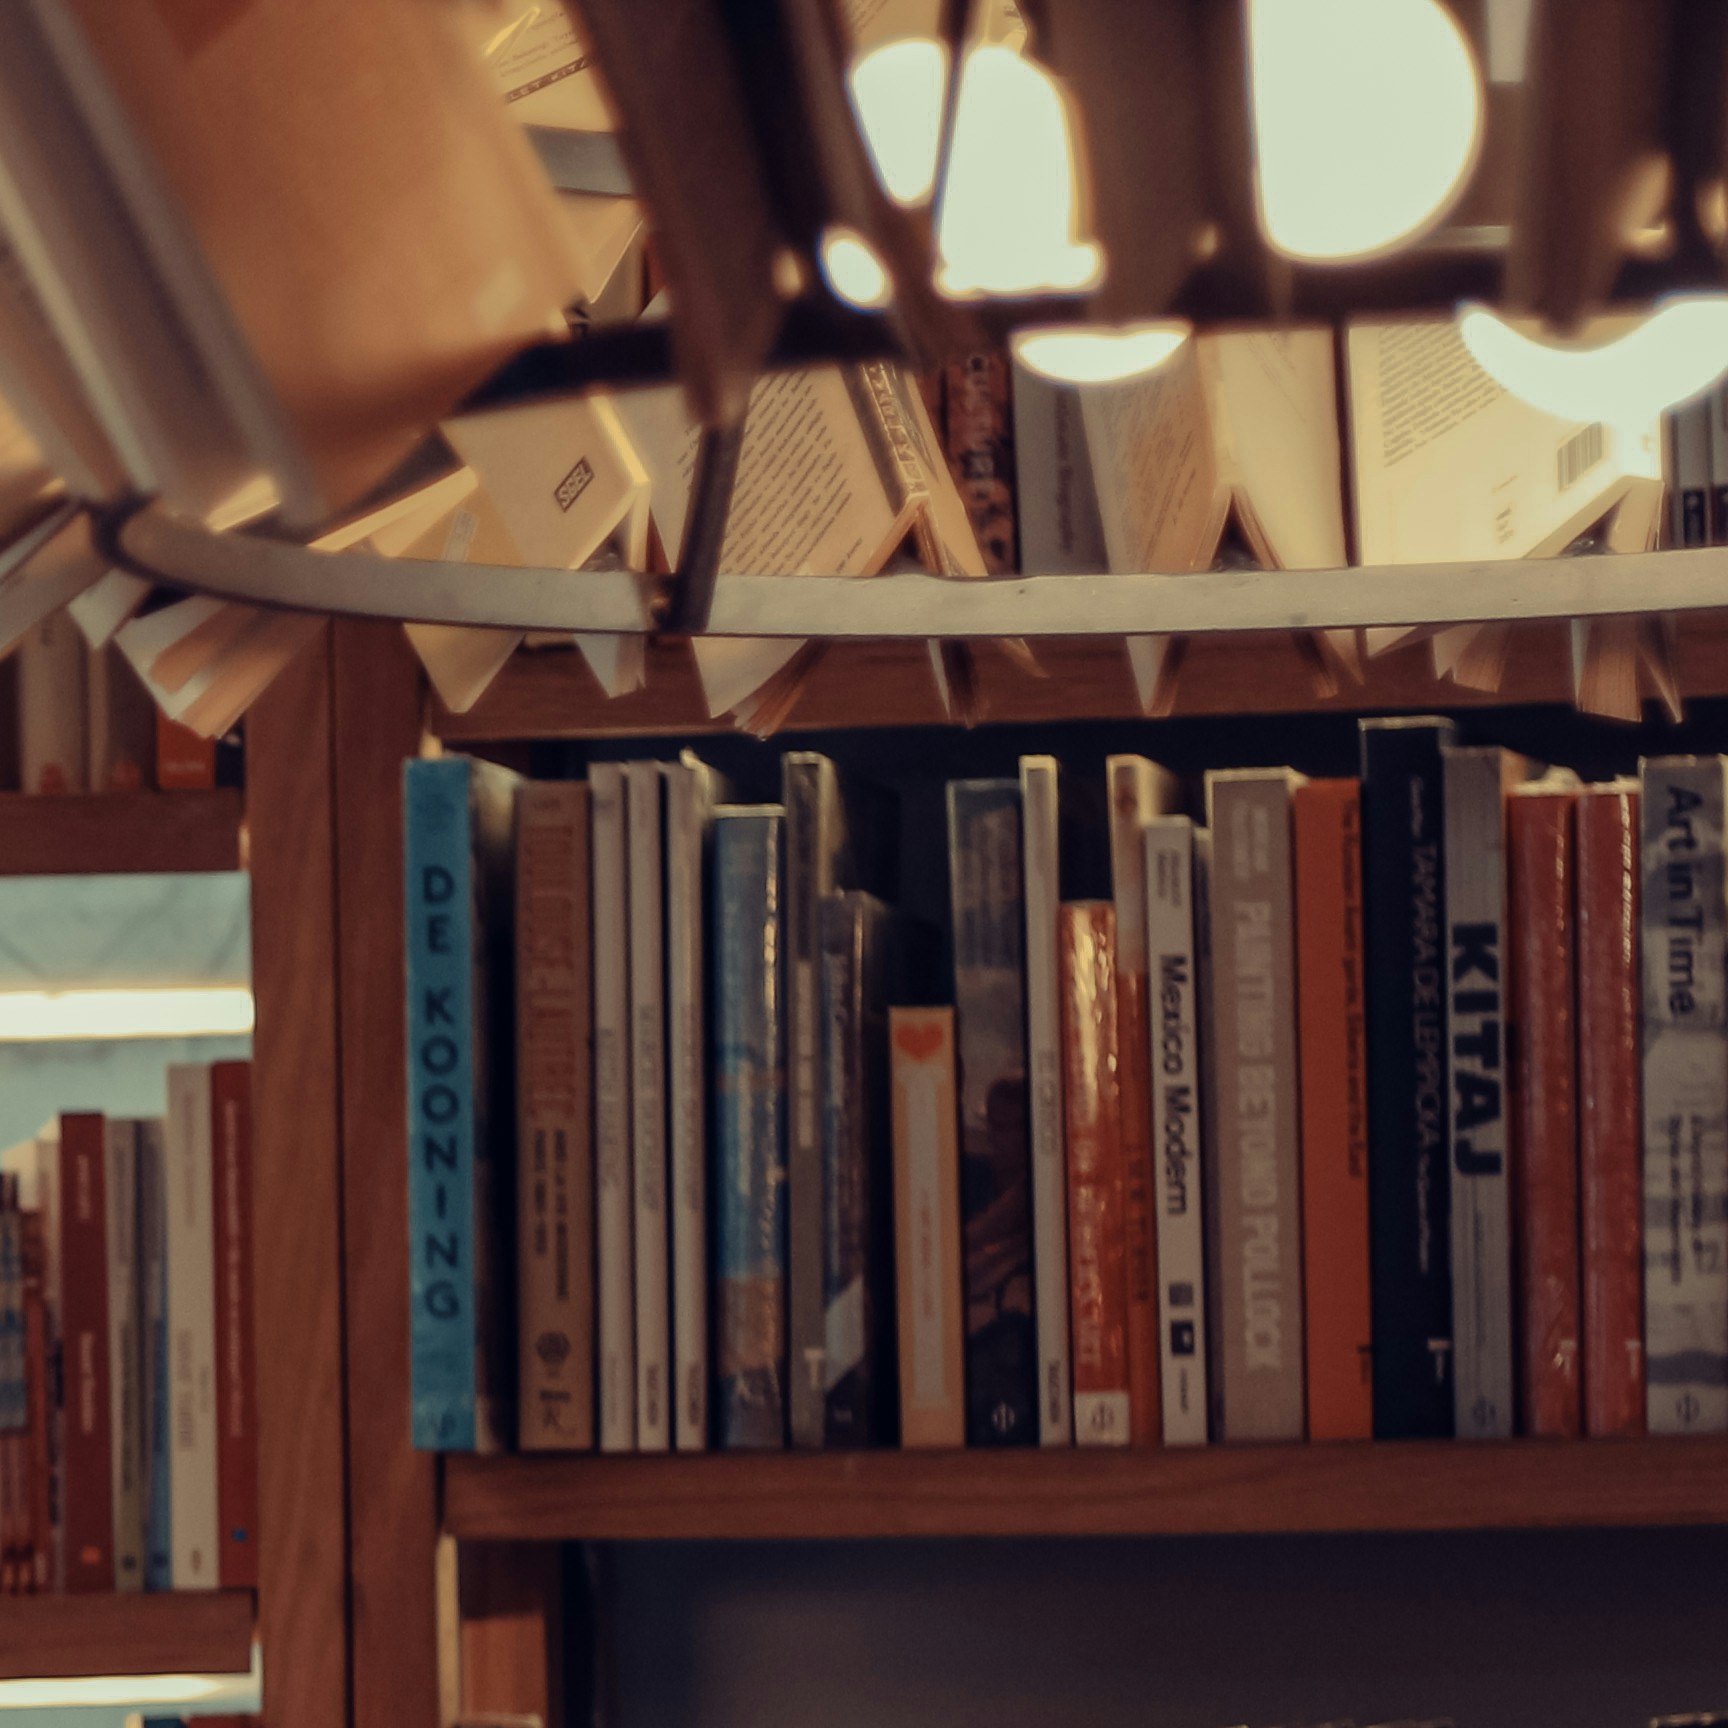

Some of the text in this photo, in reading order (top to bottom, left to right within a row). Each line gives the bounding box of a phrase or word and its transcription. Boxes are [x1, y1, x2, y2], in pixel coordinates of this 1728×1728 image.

[1664, 781, 1705, 1018] Art in Time
[420, 866, 460, 1320] DE KOONING
[1158, 954, 1193, 1217] Mexico Modern
[1451, 920, 1504, 1177] KITAJ
